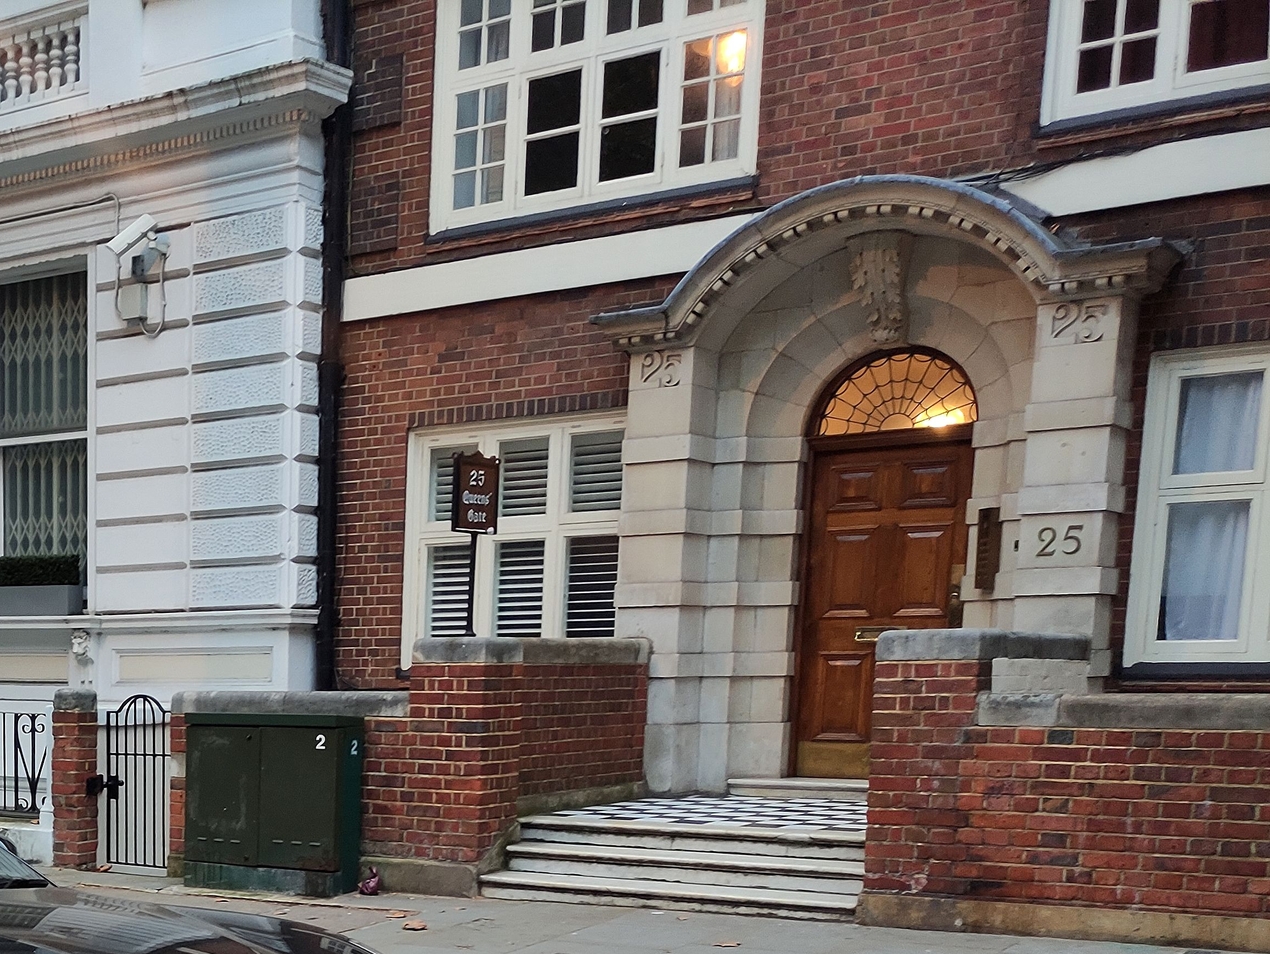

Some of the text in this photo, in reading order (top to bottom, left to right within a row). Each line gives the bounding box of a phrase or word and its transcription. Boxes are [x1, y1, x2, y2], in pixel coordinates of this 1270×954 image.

[1051, 302, 1108, 344] 25
[641, 350, 682, 388] 25
[469, 470, 485, 487] 25
[467, 509, 487, 523] Gate
[1035, 524, 1084, 557] 25
[315, 734, 326, 750] 2
[350, 740, 358, 755] 2
